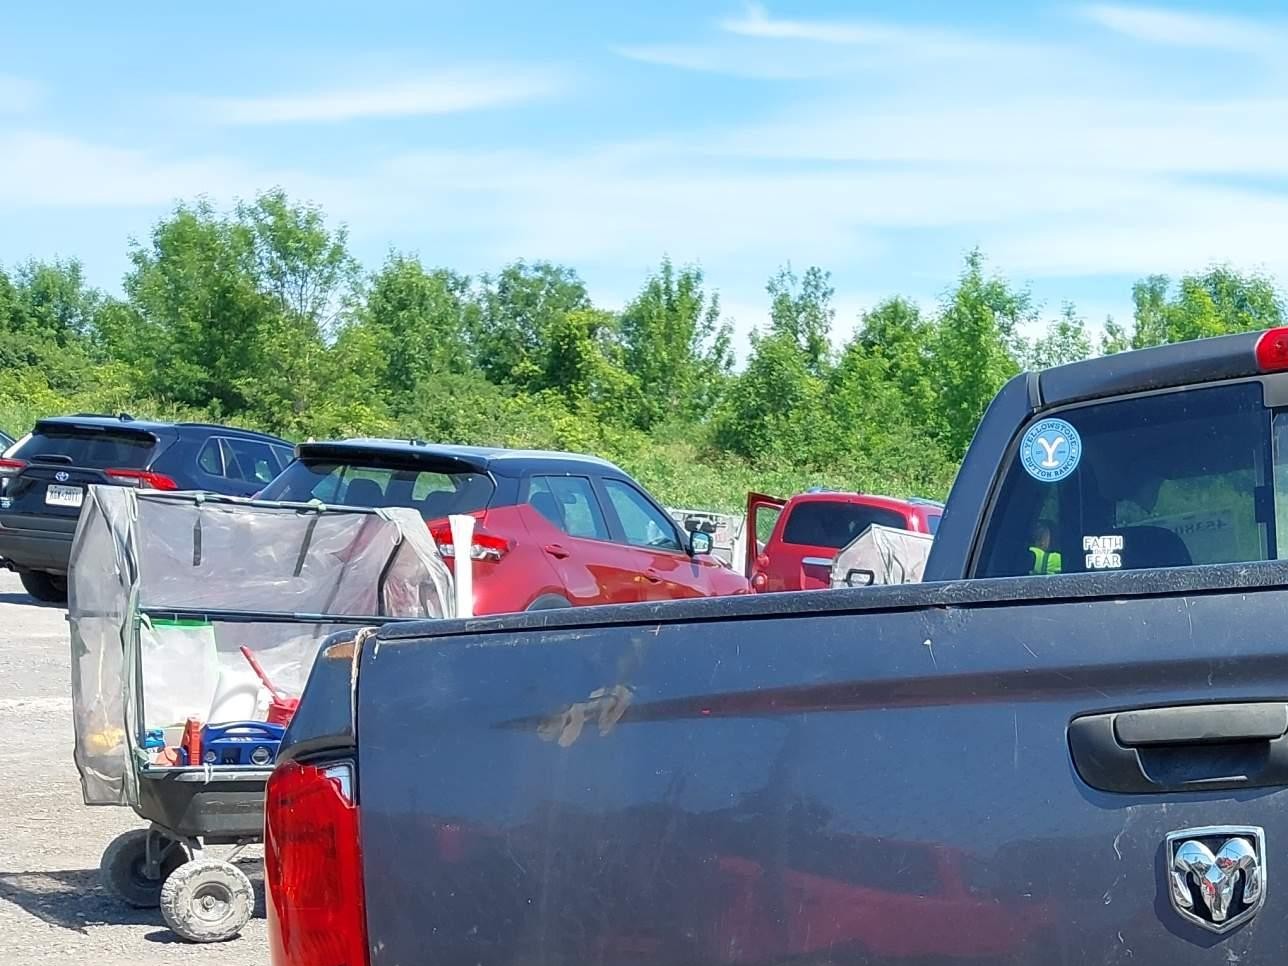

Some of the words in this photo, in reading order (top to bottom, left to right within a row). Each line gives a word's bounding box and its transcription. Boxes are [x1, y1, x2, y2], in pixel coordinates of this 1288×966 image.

[1024, 422, 1077, 449] YELLOWSTONE
[1025, 456, 1052, 478] DUTTON
[1054, 455, 1076, 478] RANCH
[1084, 536, 1123, 550] FAITH
[1087, 555, 1121, 568] FEAR
